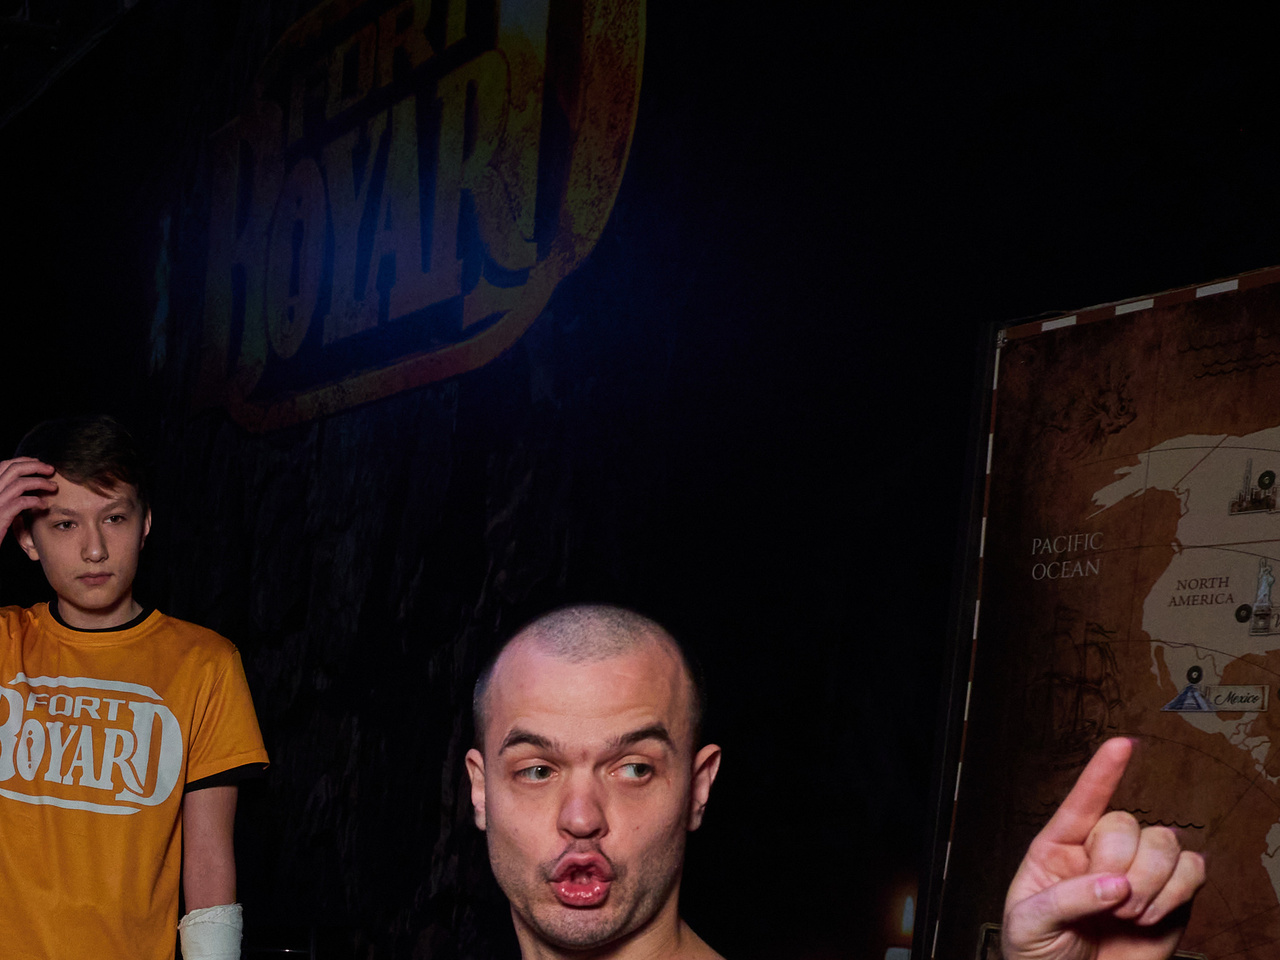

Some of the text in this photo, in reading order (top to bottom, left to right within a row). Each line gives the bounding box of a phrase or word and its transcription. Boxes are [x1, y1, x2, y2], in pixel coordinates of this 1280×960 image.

[1032, 532, 1104, 555] PACIFIC
[1032, 559, 1100, 580] OCEAN
[1176, 576, 1230, 591] NORTH
[1168, 592, 1235, 608] AMERICA
[26, 691, 126, 721] FORT
[1214, 690, 1260, 705] Mexico
